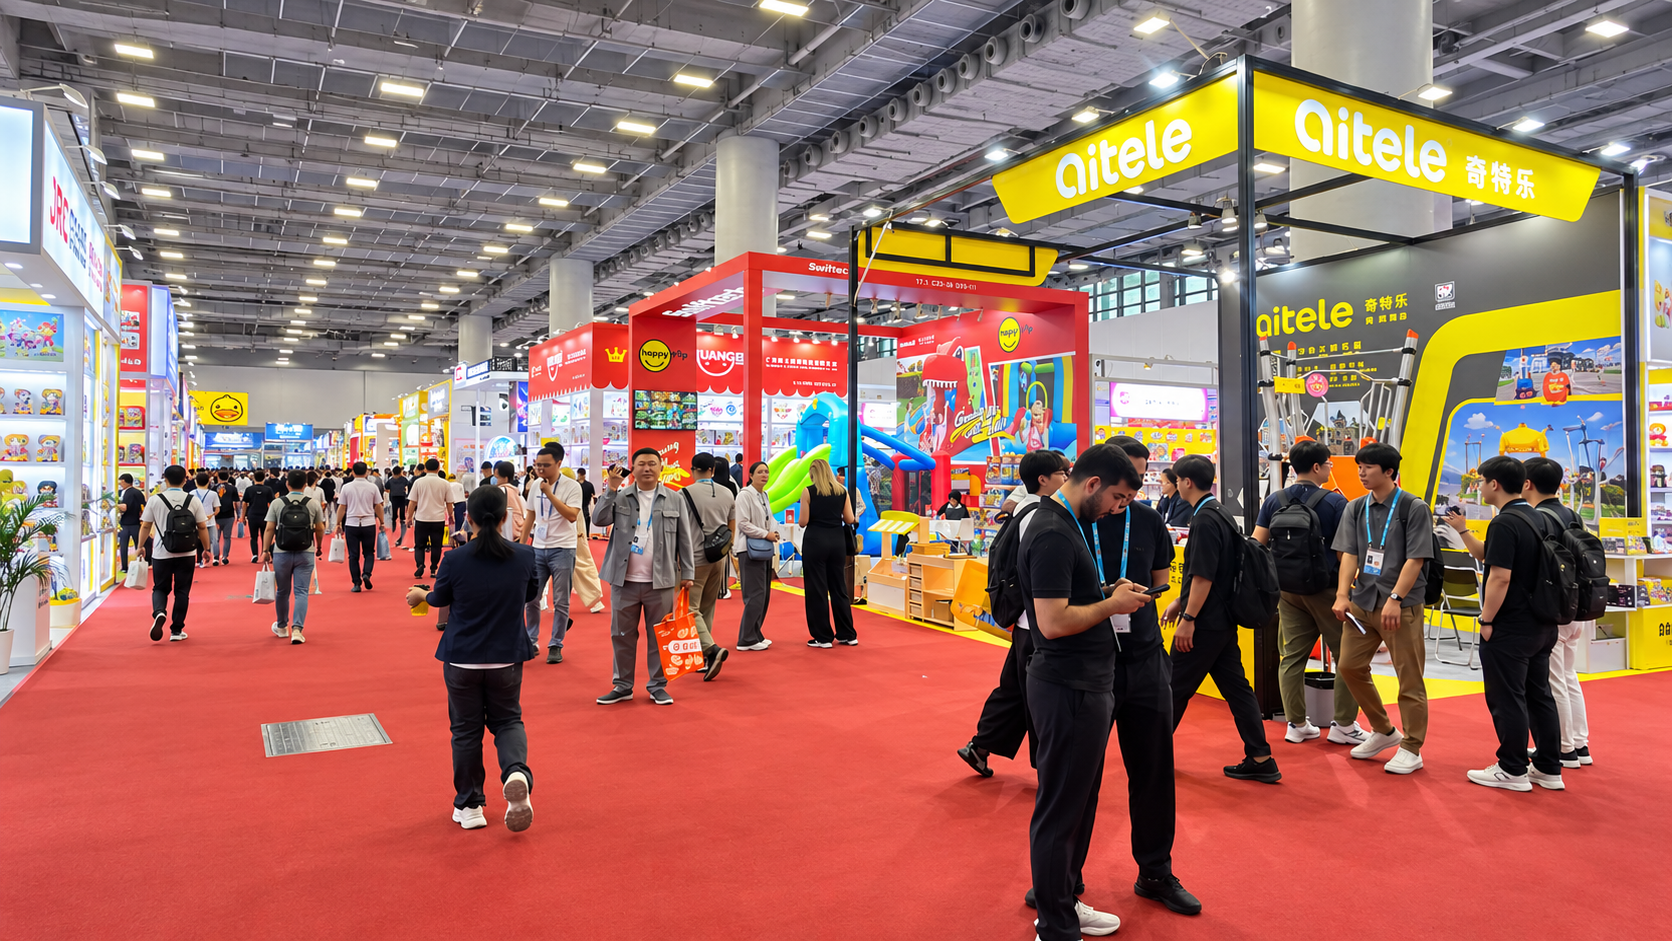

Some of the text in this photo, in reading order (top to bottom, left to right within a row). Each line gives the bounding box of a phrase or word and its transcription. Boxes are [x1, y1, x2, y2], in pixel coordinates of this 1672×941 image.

[1055, 118, 1192, 199] aitele
[1294, 98, 1447, 183] aitele
[1465, 155, 1535, 199] 奇特乐
[1255, 298, 1354, 338] aitele
[641, 348, 669, 360] happy
